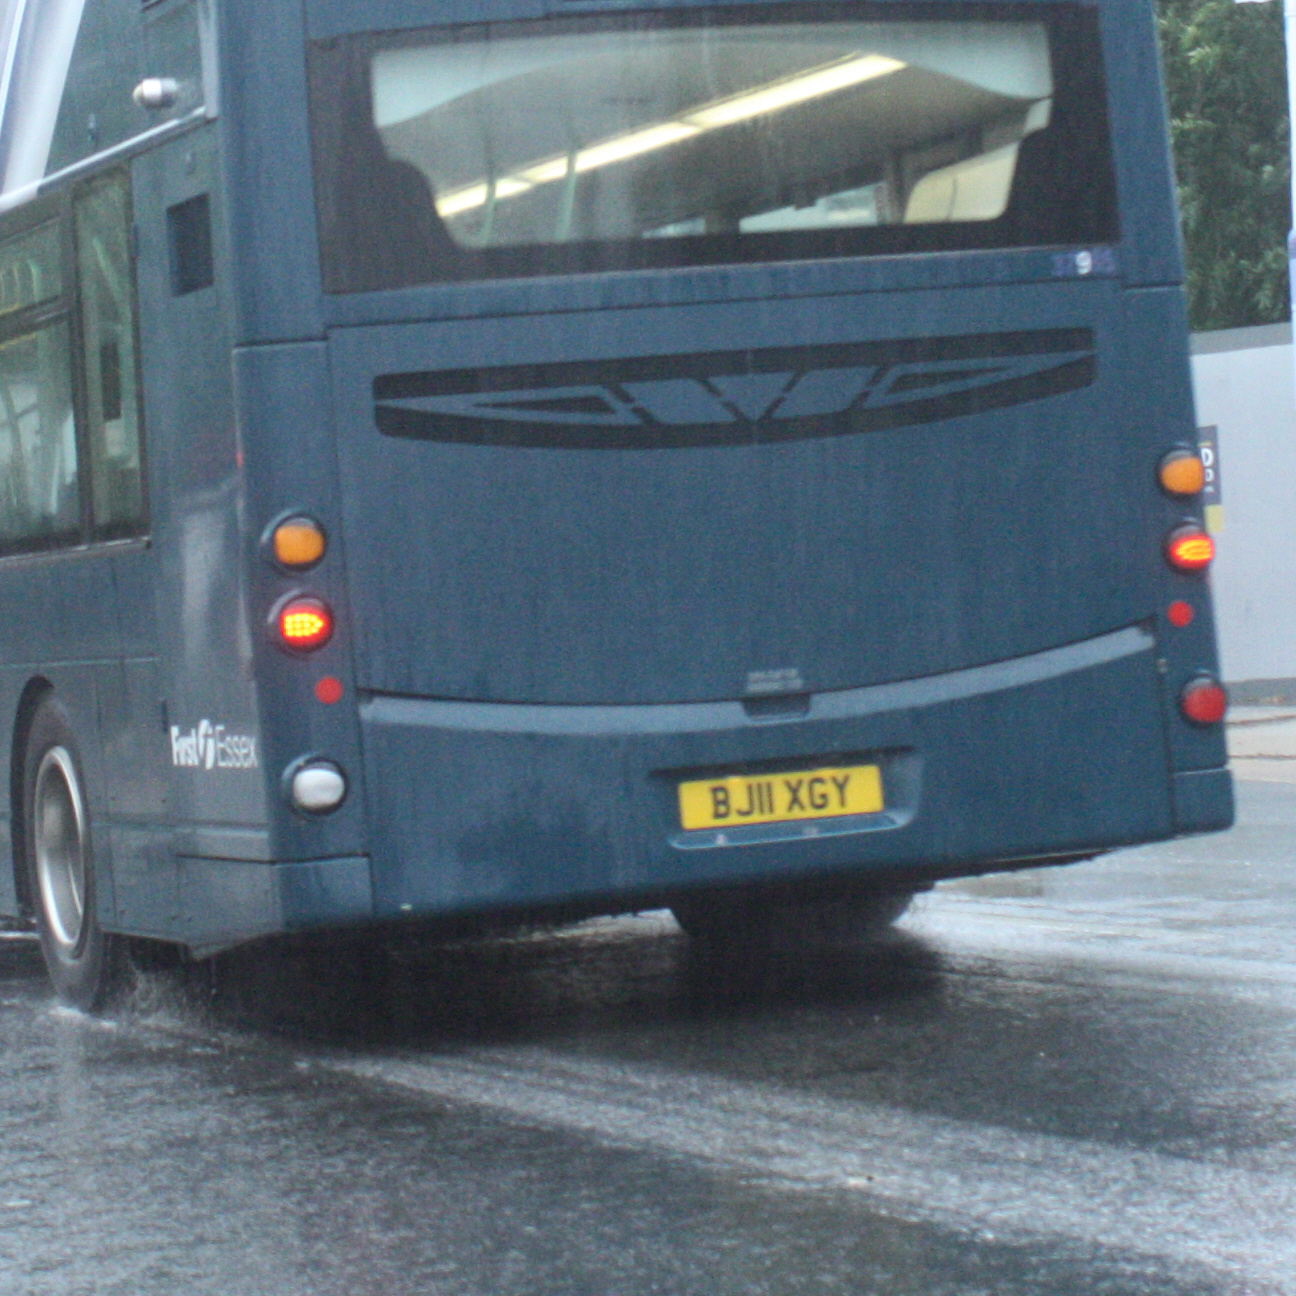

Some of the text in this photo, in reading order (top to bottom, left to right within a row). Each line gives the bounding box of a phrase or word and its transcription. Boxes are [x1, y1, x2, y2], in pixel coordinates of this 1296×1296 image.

[170, 724, 258, 768] First Essex
[710, 775, 851, 820] BJ11 XGY
